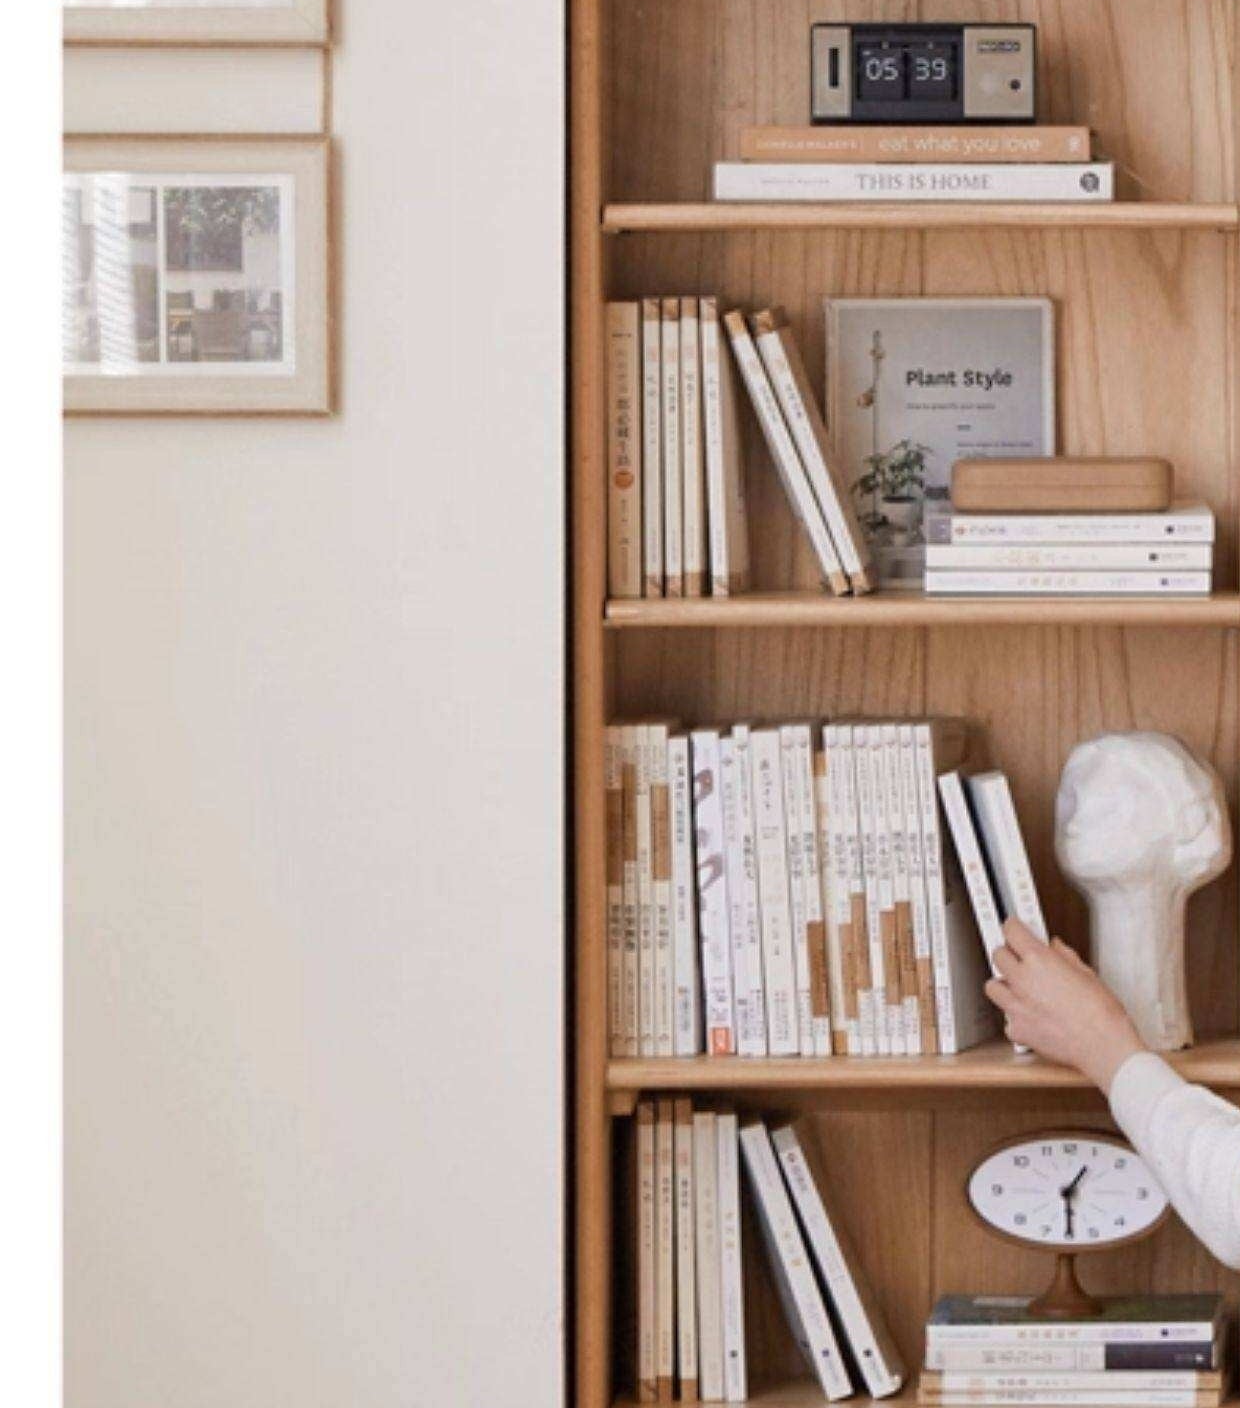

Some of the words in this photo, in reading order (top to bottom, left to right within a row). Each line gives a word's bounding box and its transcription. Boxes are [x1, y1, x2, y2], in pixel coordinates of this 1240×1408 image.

[914, 135, 958, 150] what
[963, 139, 999, 154] you
[857, 173, 902, 191] THIS
[908, 173, 927, 191] IS
[931, 173, 991, 191] HOME
[906, 368, 956, 386] Plant
[963, 368, 1012, 391] Style
